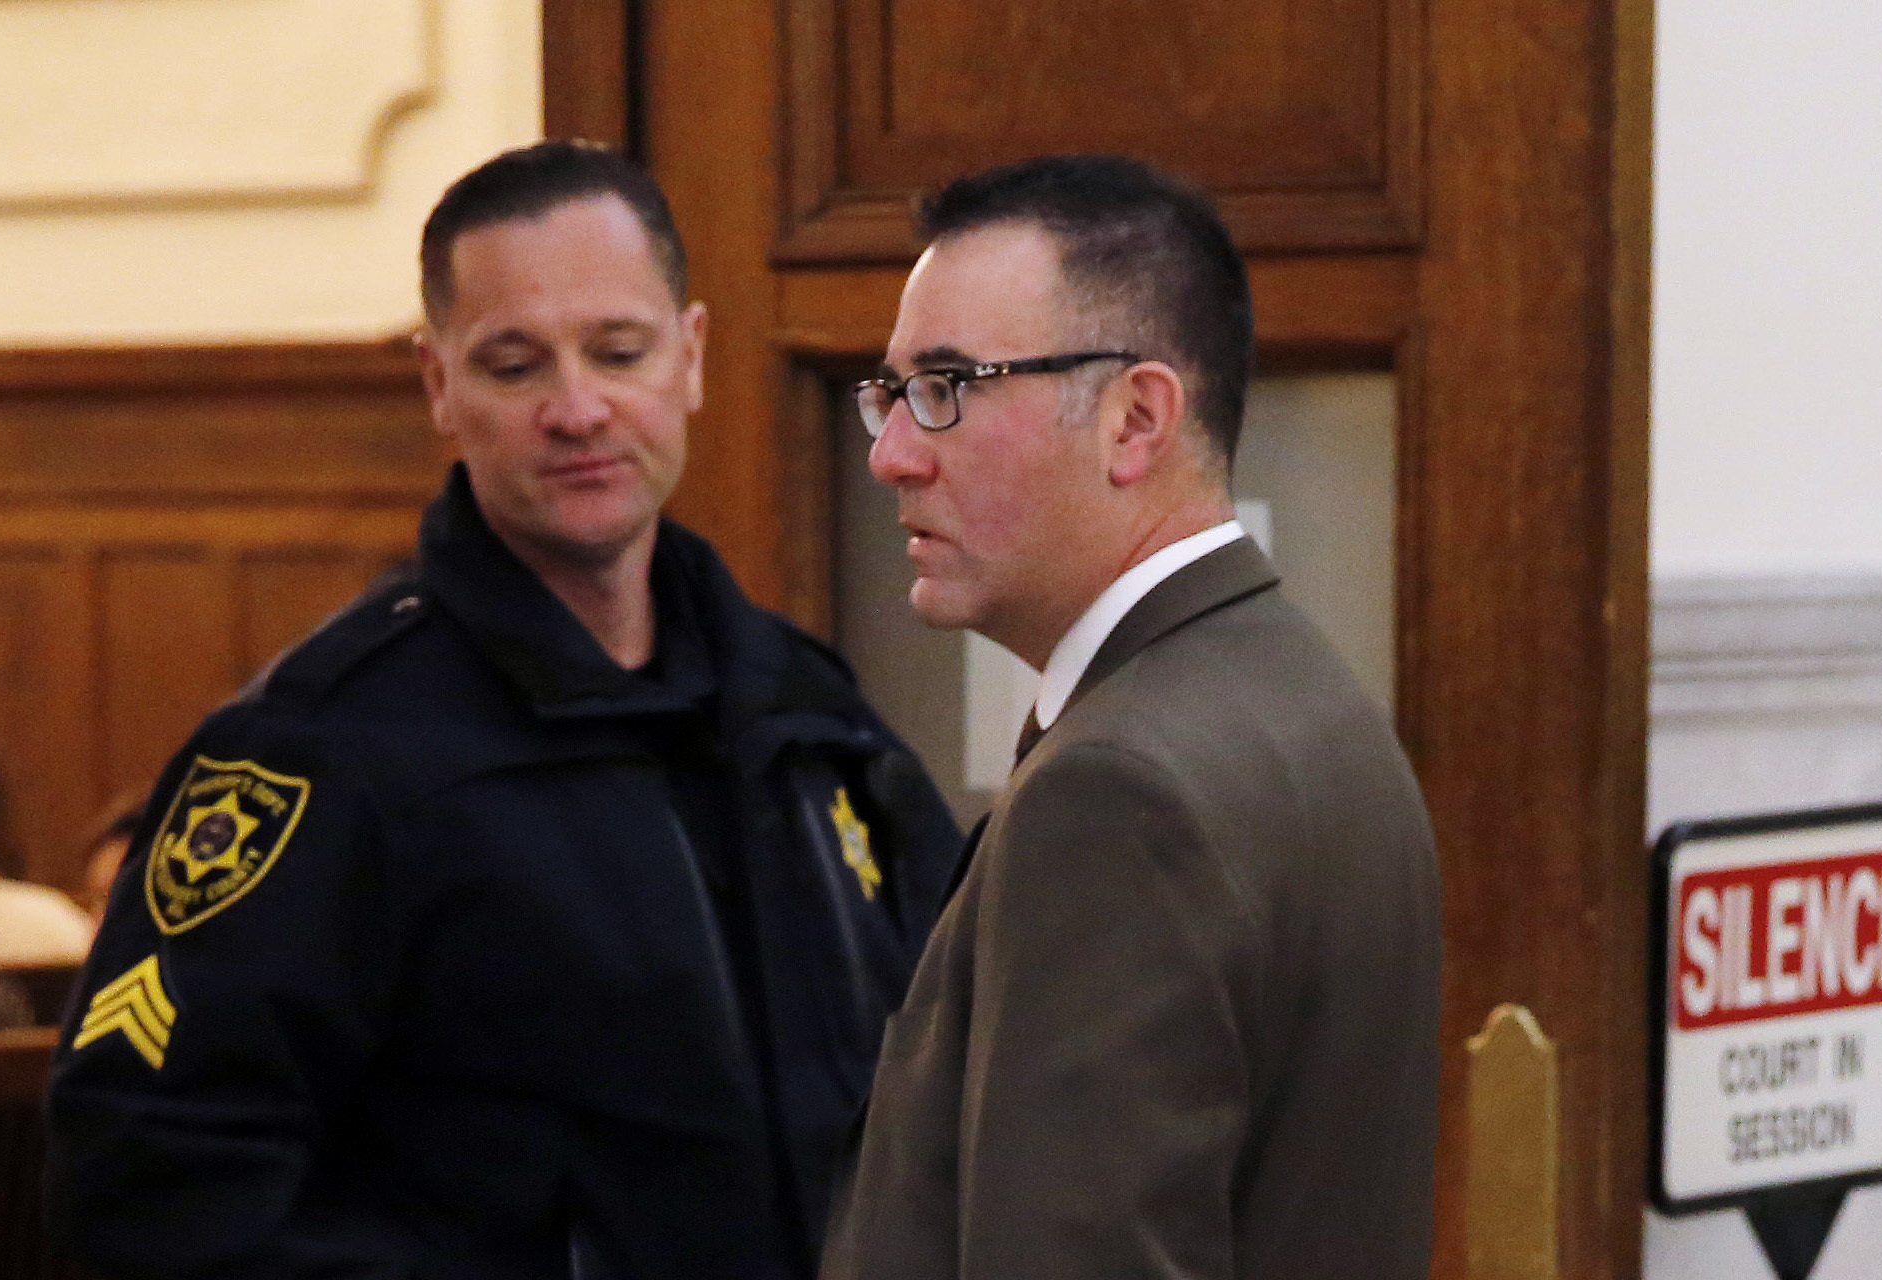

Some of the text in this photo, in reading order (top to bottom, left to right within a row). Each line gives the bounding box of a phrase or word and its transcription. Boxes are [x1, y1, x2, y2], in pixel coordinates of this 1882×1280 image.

[1722, 1033, 1864, 1094] COURT IN
[1727, 1104, 1856, 1162] SESSION
